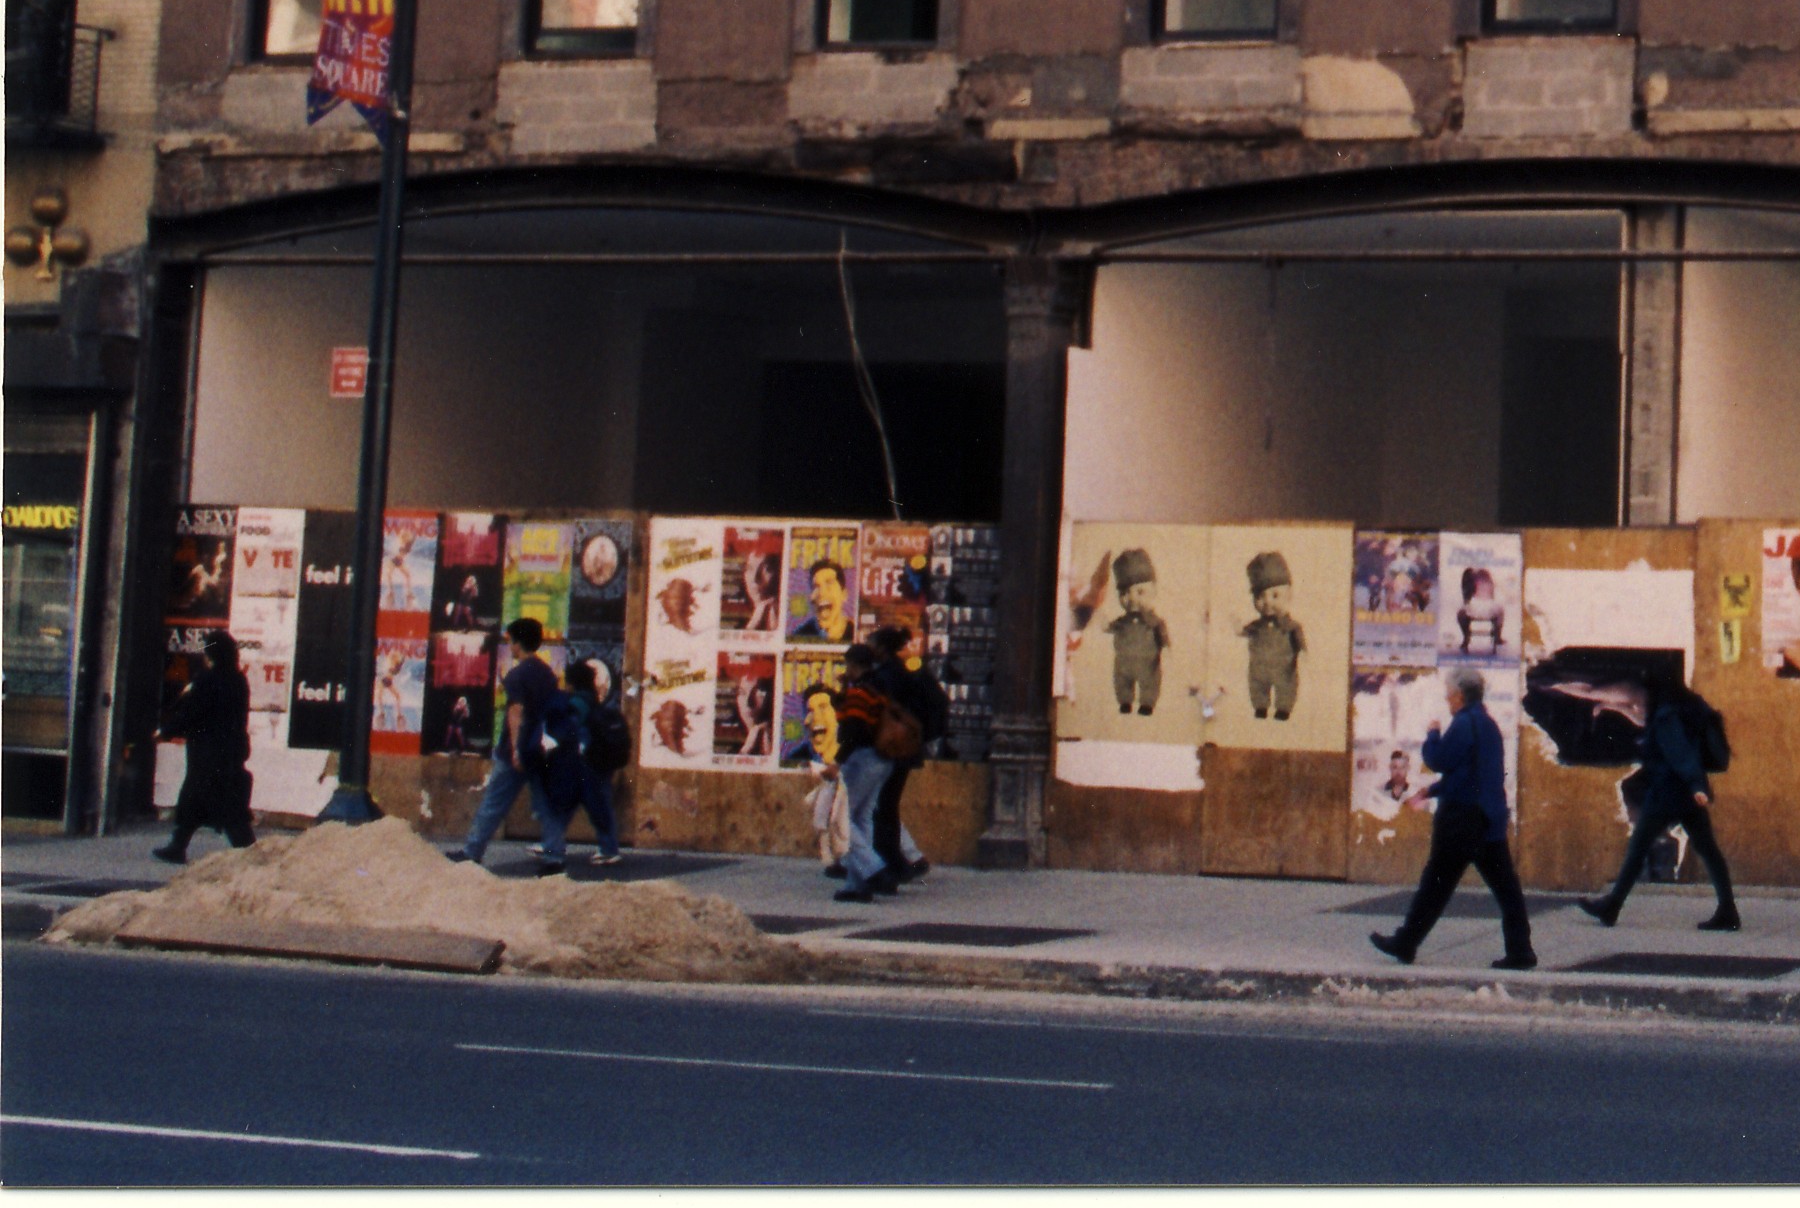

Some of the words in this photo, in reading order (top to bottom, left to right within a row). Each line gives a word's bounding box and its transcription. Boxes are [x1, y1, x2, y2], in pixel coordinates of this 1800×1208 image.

[324, 19, 391, 66] TIMES
[318, 54, 388, 96] SQUARE
[178, 511, 190, 525] A
[194, 509, 236, 524] SEXY
[791, 535, 856, 569] FREAK
[306, 564, 340, 584] feel
[297, 680, 331, 701] feel
